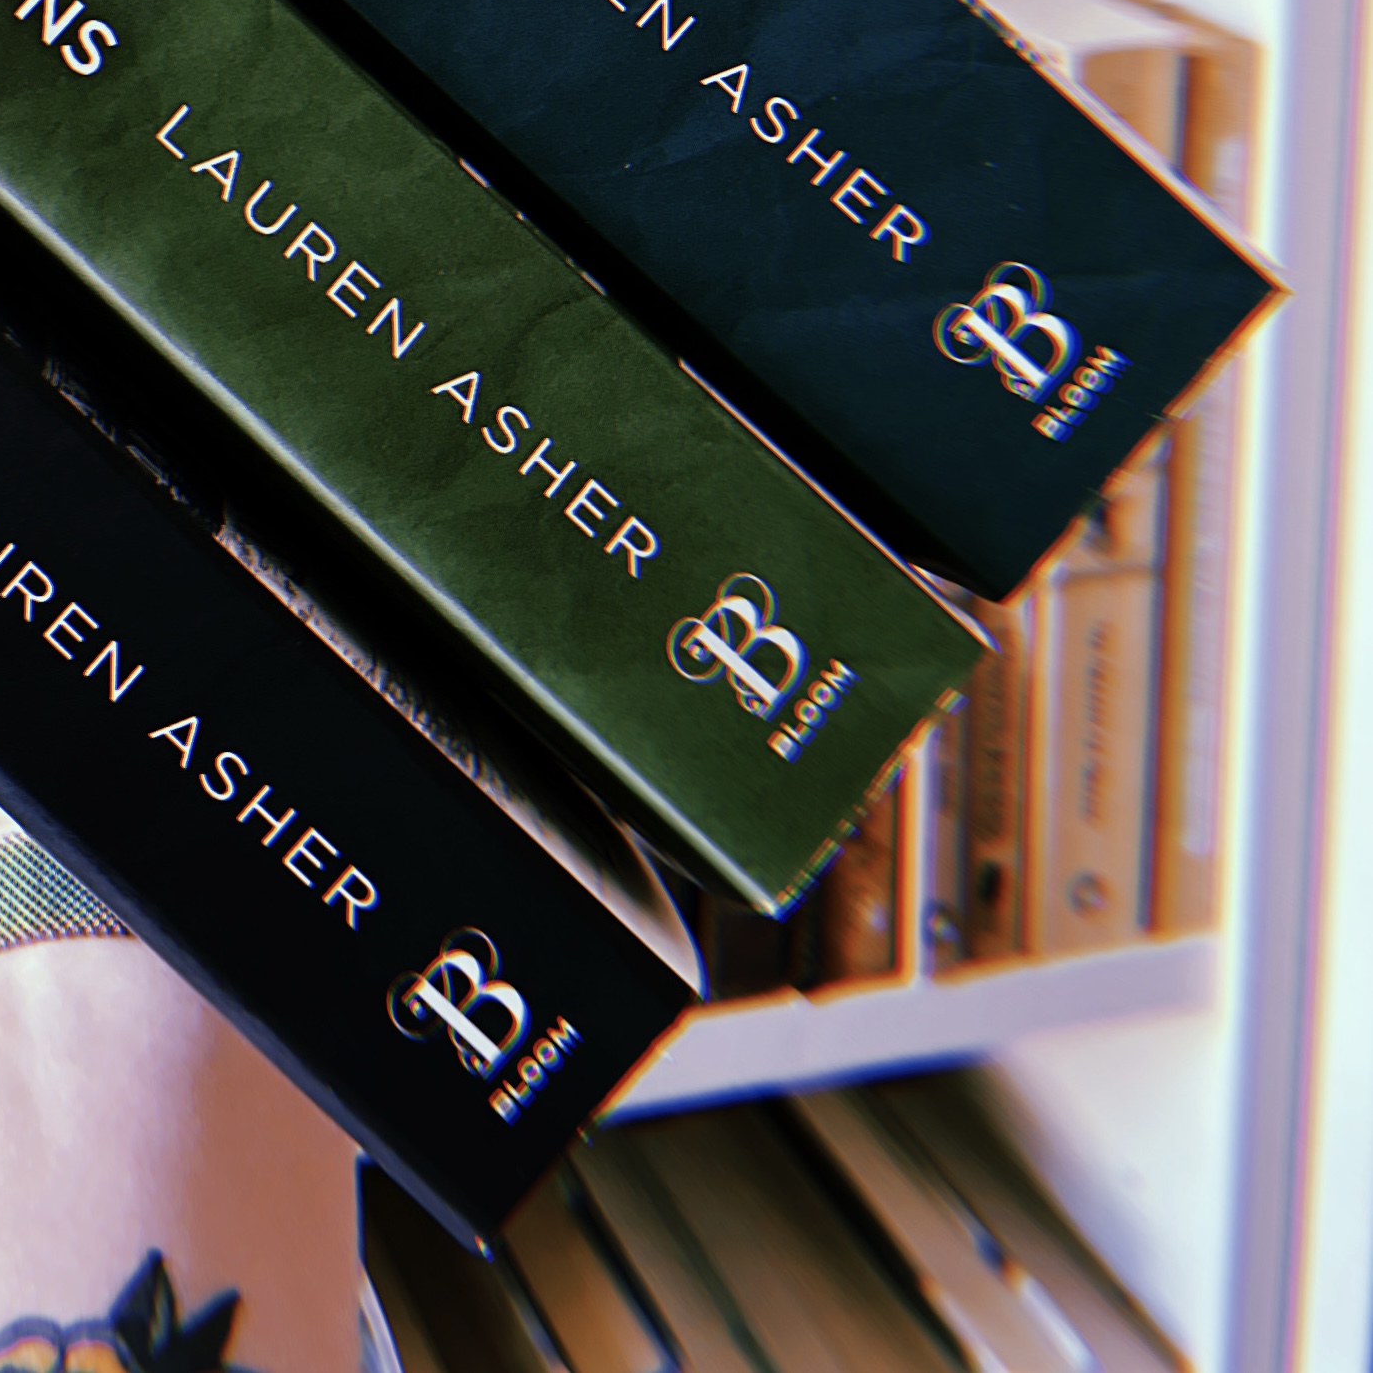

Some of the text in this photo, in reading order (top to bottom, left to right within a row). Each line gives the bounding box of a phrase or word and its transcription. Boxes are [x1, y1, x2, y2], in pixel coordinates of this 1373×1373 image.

[699, 63, 933, 264] ASHER
[155, 103, 662, 579] LAUREN ASHER
[1031, 343, 1135, 444] BLOOM
[765, 655, 860, 764] BLOOM
[148, 715, 382, 932] ASHER
[488, 1014, 585, 1126] BLOOM
